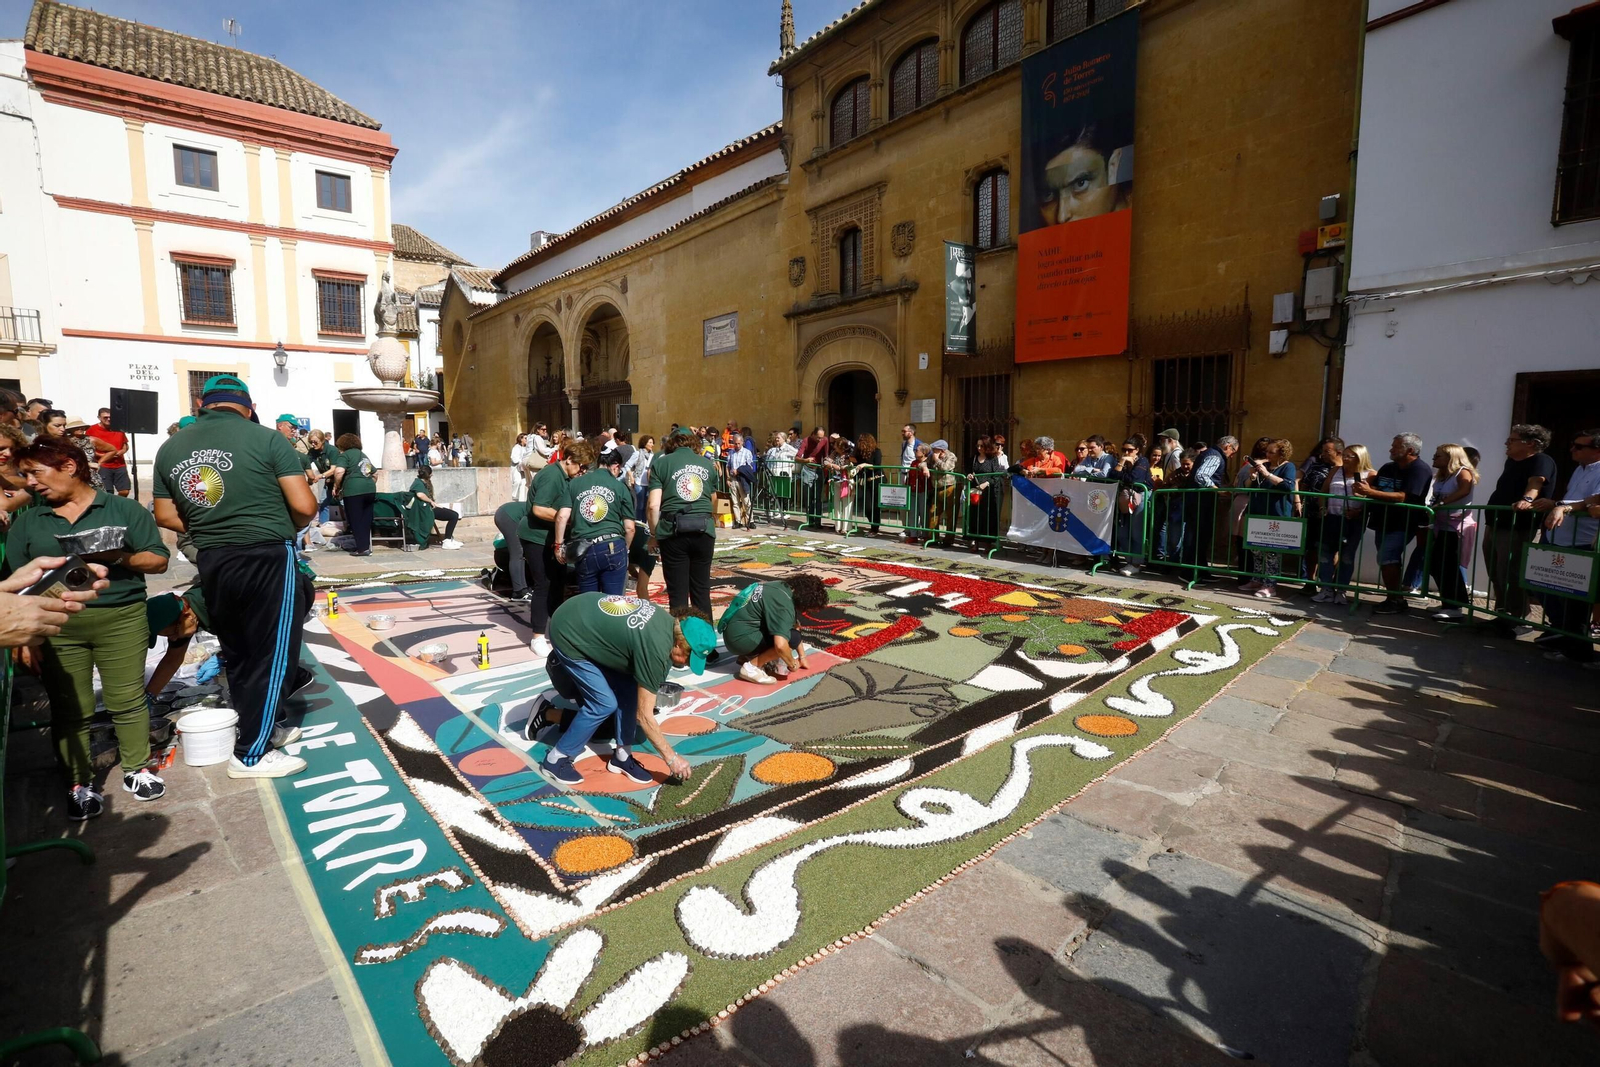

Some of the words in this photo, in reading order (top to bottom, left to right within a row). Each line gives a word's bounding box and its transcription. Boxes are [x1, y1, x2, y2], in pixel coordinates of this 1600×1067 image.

[1064, 65, 1082, 76] Julio
[1083, 53, 1111, 69] Romero
[1063, 76, 1072, 85] de
[1072, 68, 1096, 81] Torres
[1037, 260, 1055, 269] logra
[1056, 254, 1082, 264] ocultar
[1084, 249, 1103, 260] nada
[1038, 246, 1061, 257] NADIE
[1037, 268, 1063, 279] cuando
[1064, 266, 1083, 275] mira
[1068, 276, 1080, 286] los
[191, 448, 233, 472] CORPUS
[1530, 564, 1559, 575] AYUNTAMIENTO
[293, 758, 508, 966] TORRES
